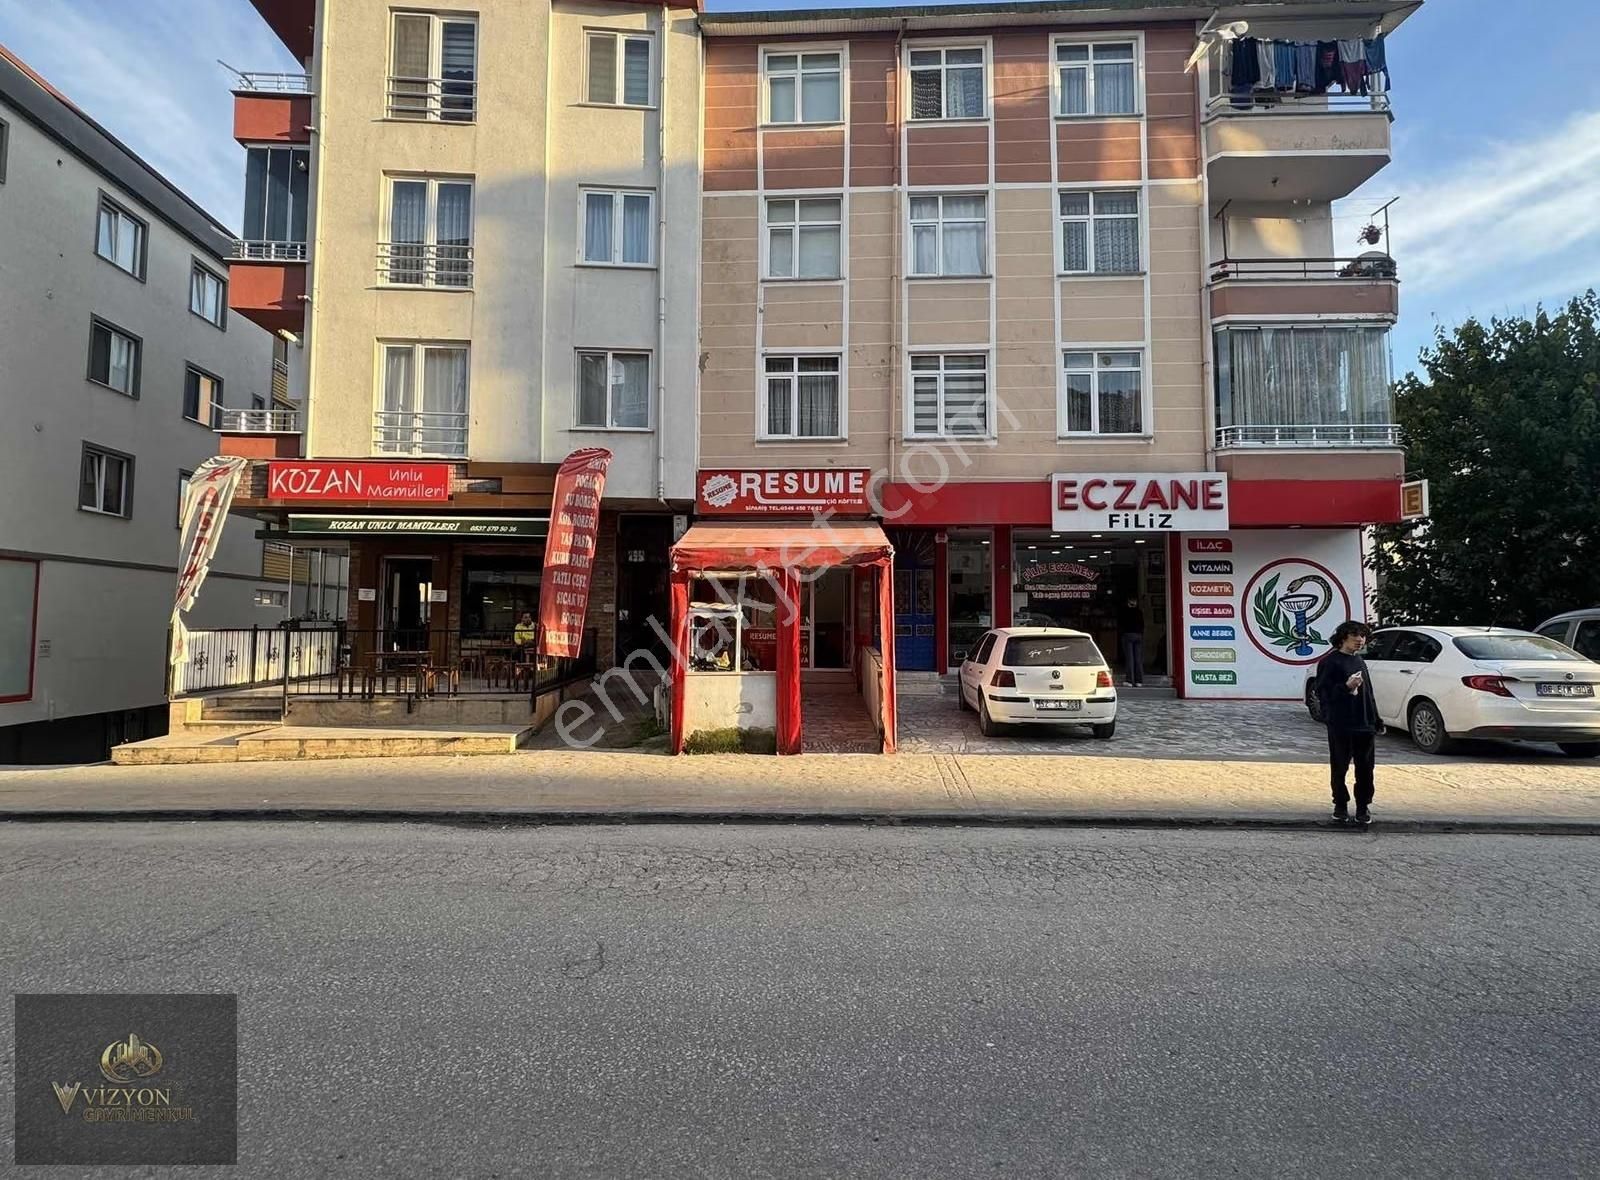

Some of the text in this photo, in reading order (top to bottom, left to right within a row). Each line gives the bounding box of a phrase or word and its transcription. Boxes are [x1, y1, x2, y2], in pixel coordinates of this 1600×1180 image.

[271, 468, 363, 494] KOZAN
[389, 469, 423, 481] Unlu
[367, 484, 446, 497] Mamülleri
[740, 471, 864, 499] RESUME
[1057, 478, 1224, 511] ECZANE
[328, 520, 366, 530] KOZAN
[1196, 539, 1224, 551] İLAÇ
[1191, 562, 1231, 572] VİTAMİN
[553, 571, 571, 585] TATLI
[1190, 583, 1232, 593] KOZMETİK
[750, 632, 777, 640] RESUME
[1192, 629, 1233, 637] ANNE BEBEK
[1195, 673, 1217, 681] HASTA
